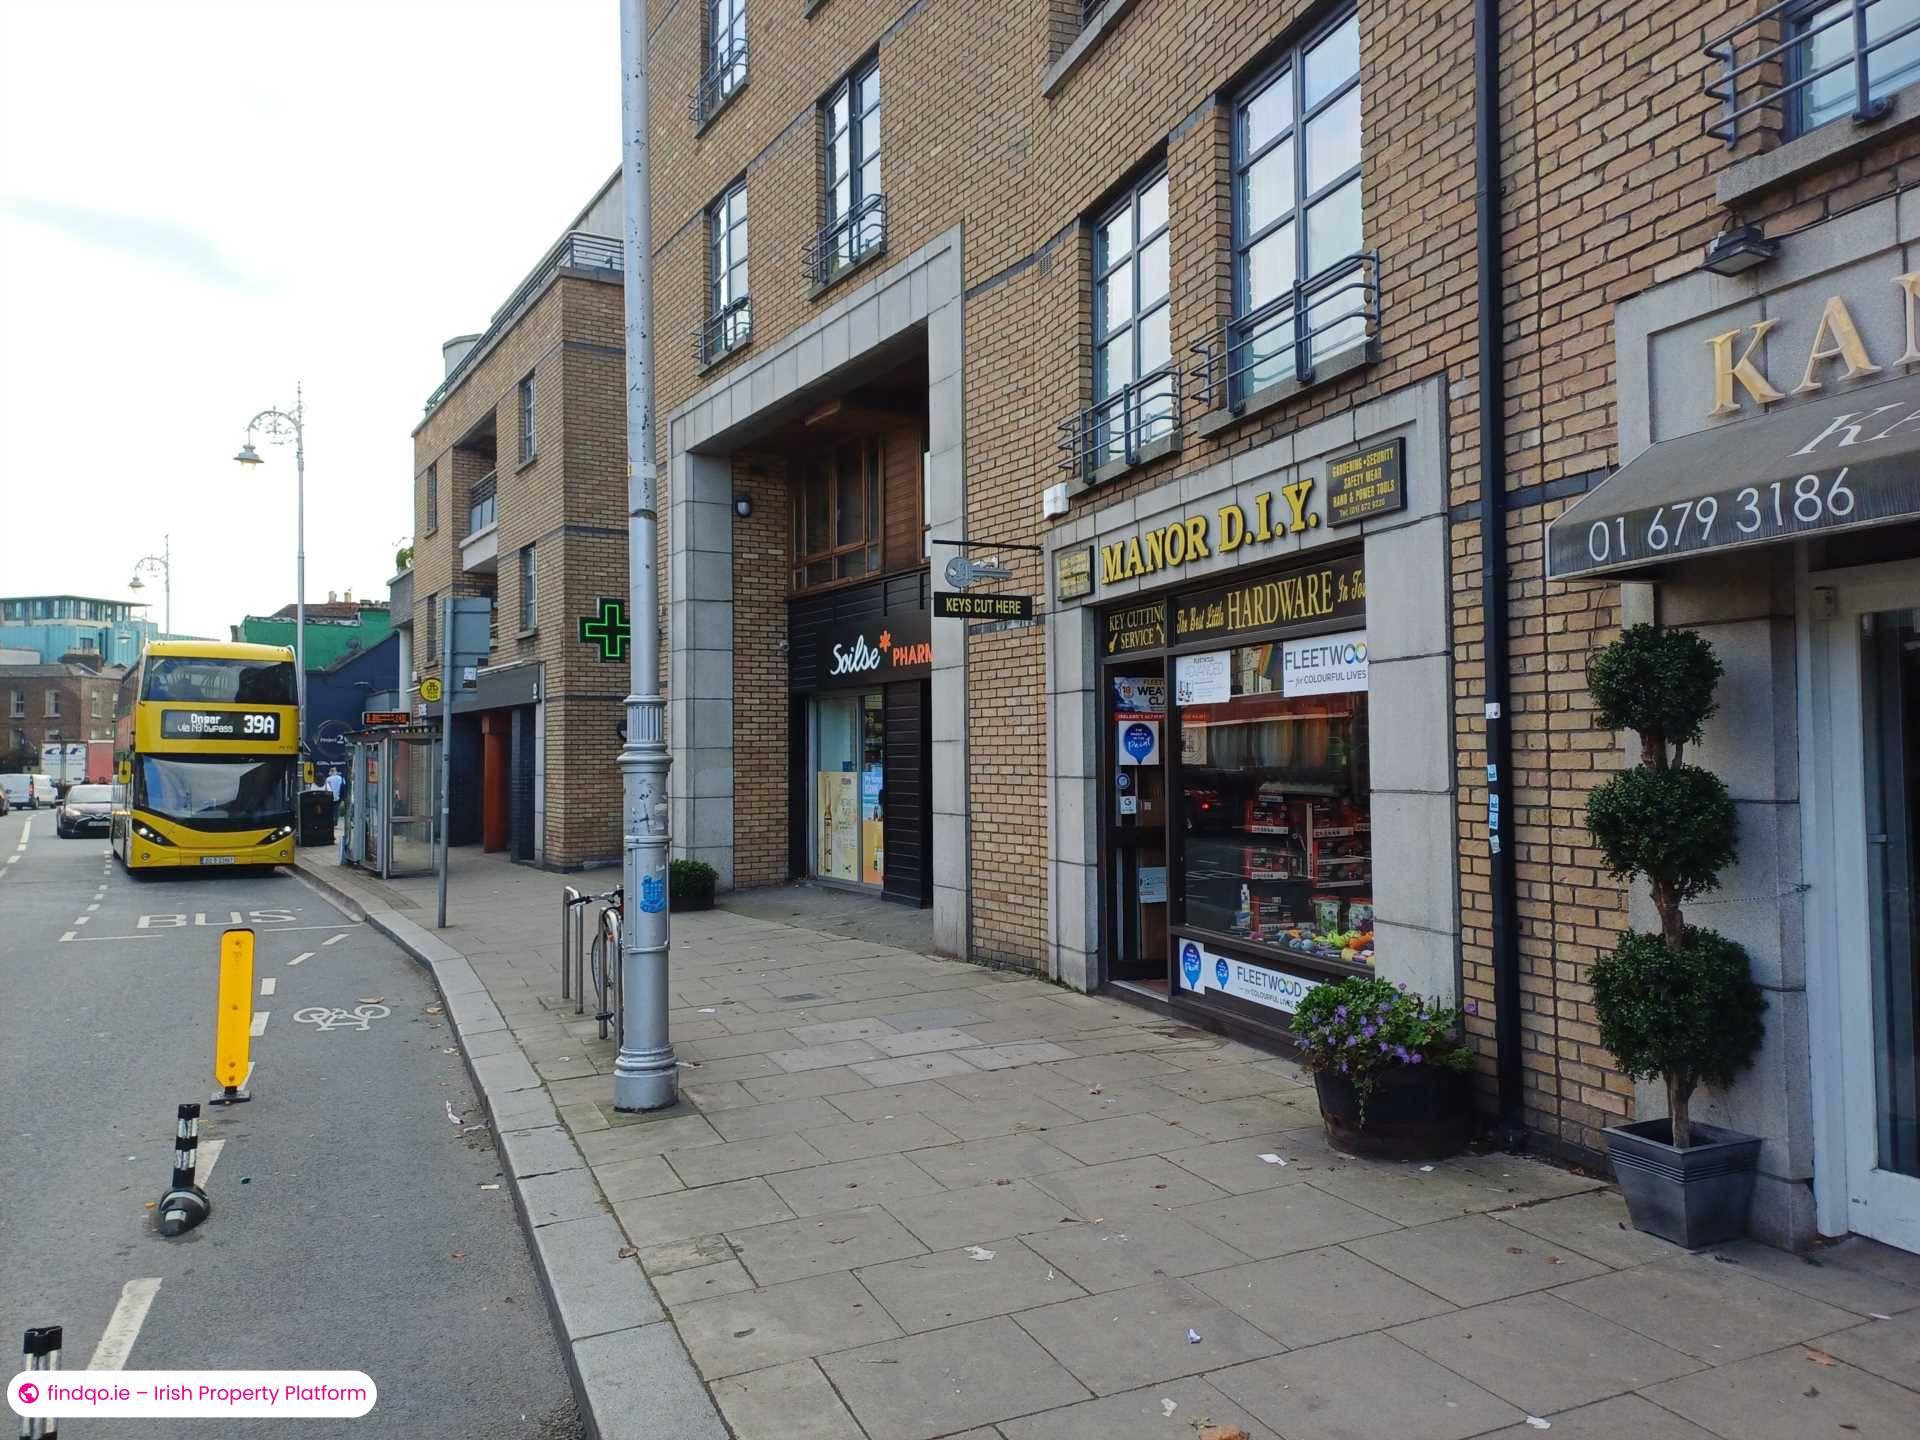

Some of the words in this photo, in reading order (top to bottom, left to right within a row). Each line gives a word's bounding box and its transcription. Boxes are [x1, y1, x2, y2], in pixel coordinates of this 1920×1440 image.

[1332, 457, 1362, 478] GARDENING
[1366, 447, 1394, 467] SECURITY
[1344, 473, 1364, 490] SAFETY
[1366, 467, 1382, 482] WEAR
[1333, 493, 1348, 508] HAND
[1356, 485, 1375, 501] POWER
[1376, 479, 1395, 495] TOOLS
[1588, 517, 1627, 562] 01
[1647, 496, 1719, 550] 679
[1735, 467, 1855, 533] 3186
[1102, 513, 1209, 585] MANOR
[1218, 478, 1319, 553] D.I.Y.
[946, 597, 972, 613] KEYS
[974, 598, 994, 614] CUT
[995, 598, 1022, 615] HERE
[1177, 609, 1188, 634] The
[1189, 607, 1204, 631] Best
[1206, 600, 1225, 629] Little
[1227, 570, 1334, 631] HARDWARE
[1337, 574, 1348, 603] In
[1109, 613, 1126, 633] KEY
[1120, 628, 1154, 650] SERVICE
[829, 634, 881, 676] Soilse
[1304, 673, 1345, 685] COLOURFUL
[1346, 670, 1367, 681] LIVES
[243, 714, 275, 734] 39A
[136, 909, 297, 929] BUS
[1237, 966, 1303, 997] FLEETWOOD
